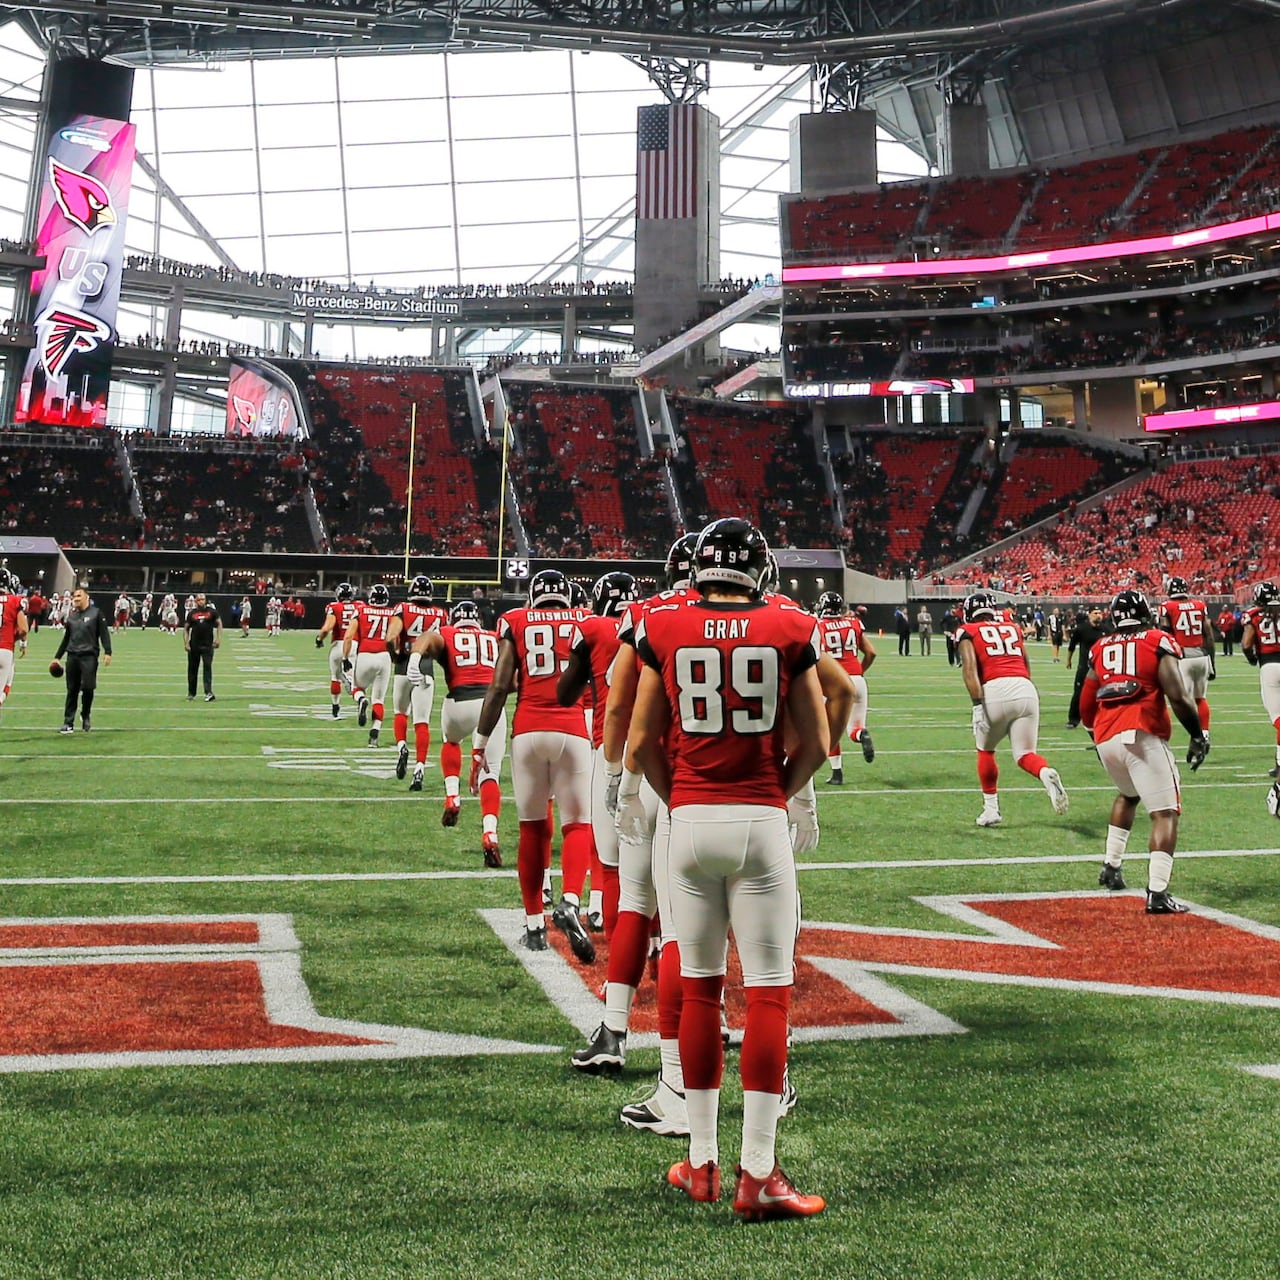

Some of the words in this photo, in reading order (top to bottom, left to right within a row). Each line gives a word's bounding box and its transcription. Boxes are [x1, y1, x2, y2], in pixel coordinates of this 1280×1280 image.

[292, 292, 398, 311] Mercedes-Benz
[401, 297, 459, 315] Stadium
[714, 549, 737, 563] 89
[508, 561, 528, 577] 25
[706, 572, 744, 581] FALCONS
[407, 616, 441, 637] 44
[527, 611, 583, 622] GRISWOLD
[1176, 611, 1203, 635] 45
[368, 617, 388, 641] 71
[704, 619, 749, 640] GRAY
[455, 634, 498, 667] 90
[825, 630, 858, 658] 94
[981, 626, 1022, 656] 92
[1102, 642, 1136, 677] 91
[675, 646, 779, 734] 89
